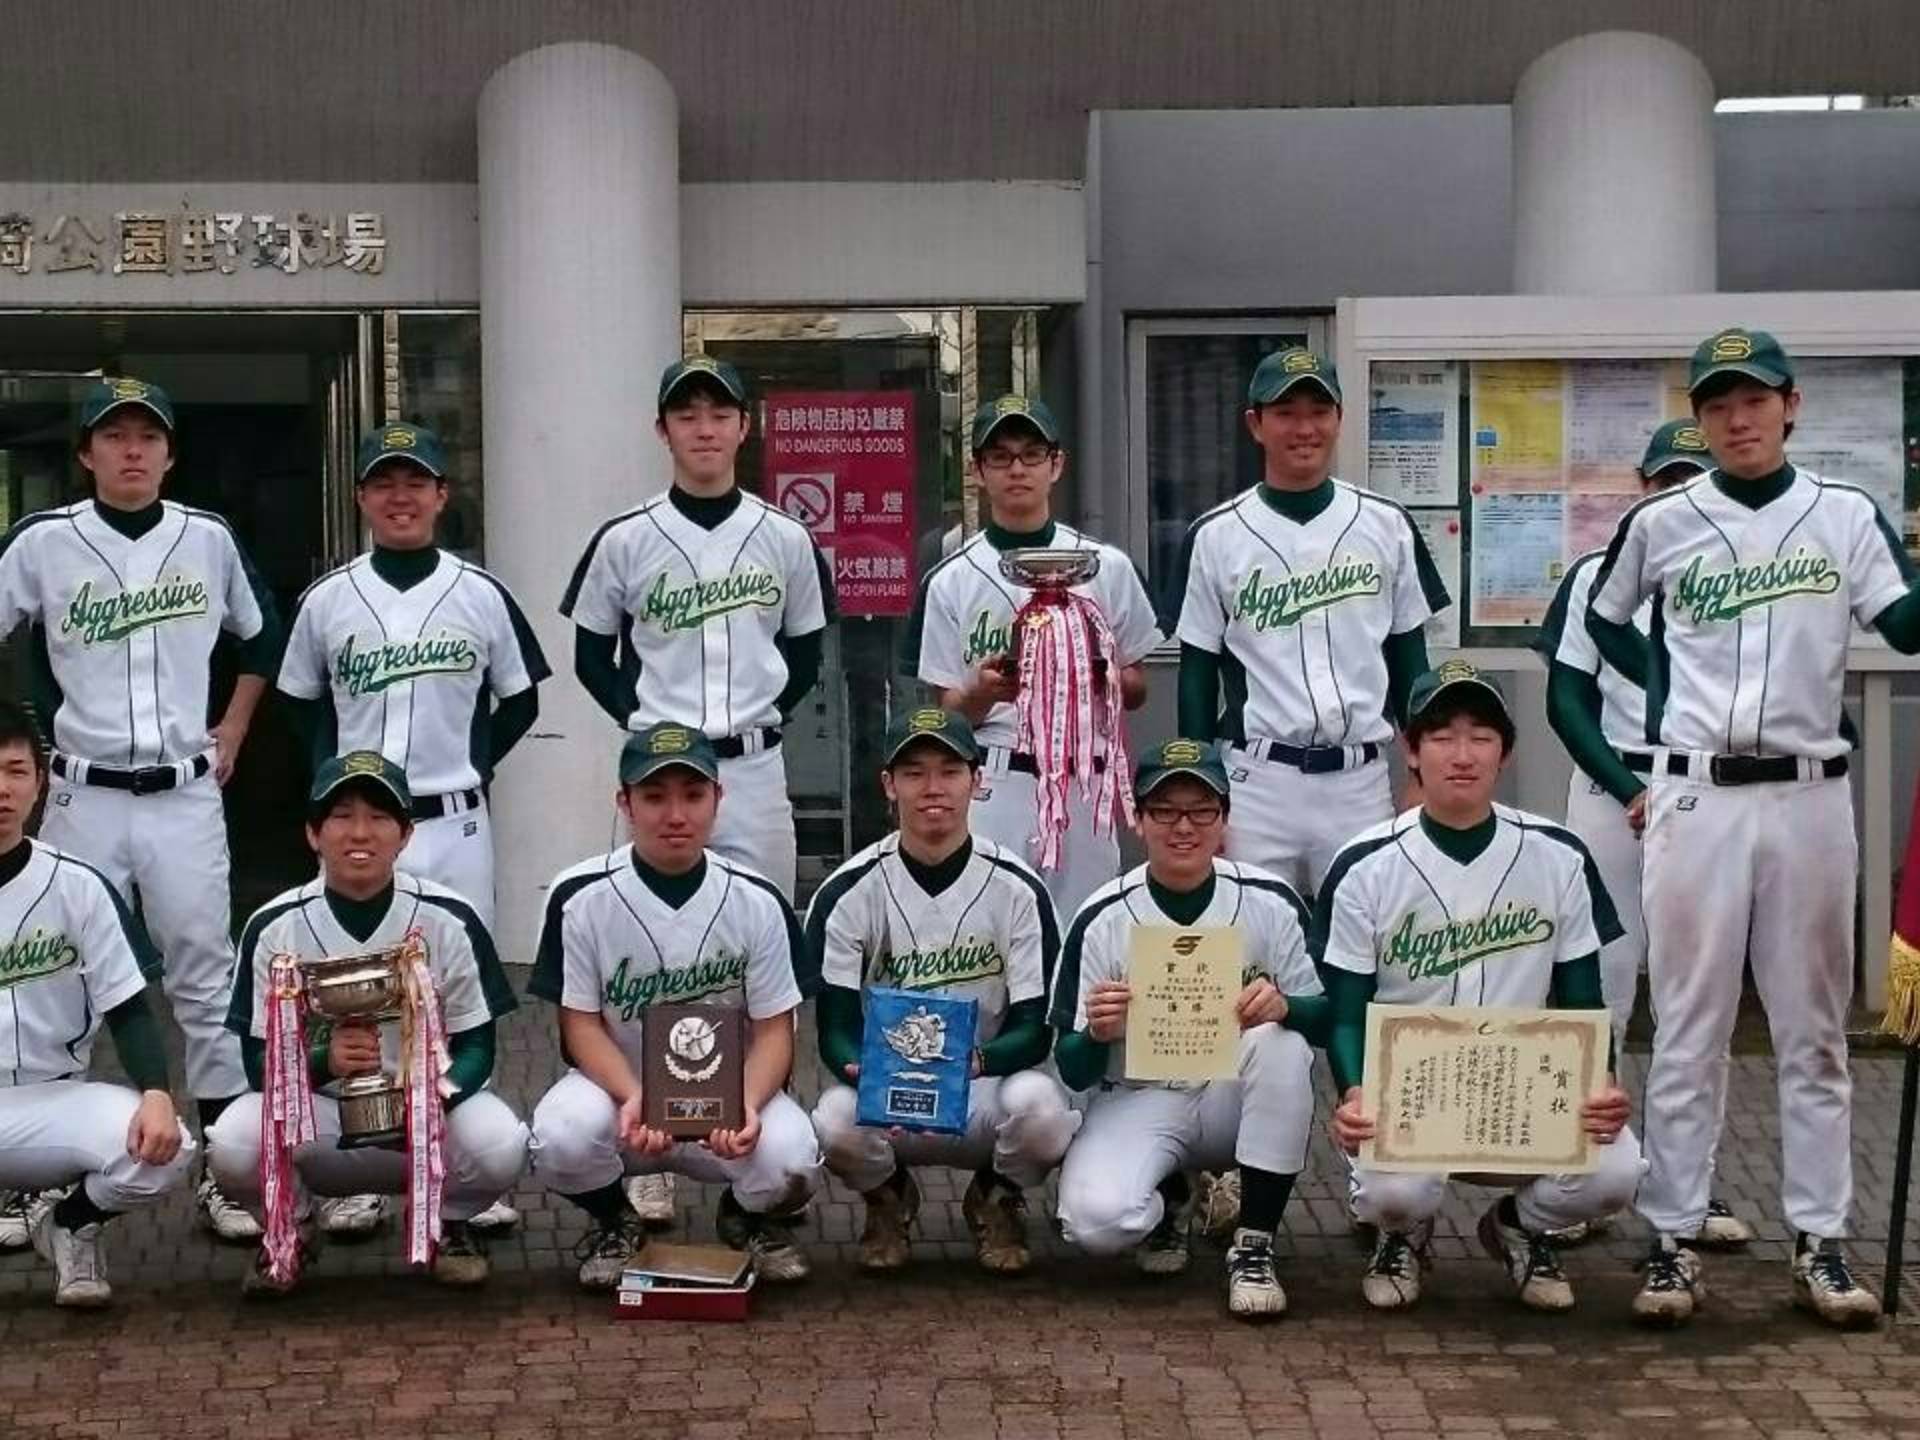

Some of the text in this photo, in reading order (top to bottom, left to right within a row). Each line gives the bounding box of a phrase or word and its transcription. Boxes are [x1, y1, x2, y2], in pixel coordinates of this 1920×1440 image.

[775, 437, 905, 453] NO DANGEROUS GOODS
[641, 565, 781, 632] Aggressive
[837, 557, 907, 578] 火気厳禁
[1234, 556, 1382, 632] Aggressive
[1674, 547, 1841, 624] Aggressive
[62, 575, 209, 644] Aggressive
[336, 630, 477, 696] Aggressive
[1384, 901, 1555, 981] Aggressive
[606, 949, 748, 1021] Aggressiv
